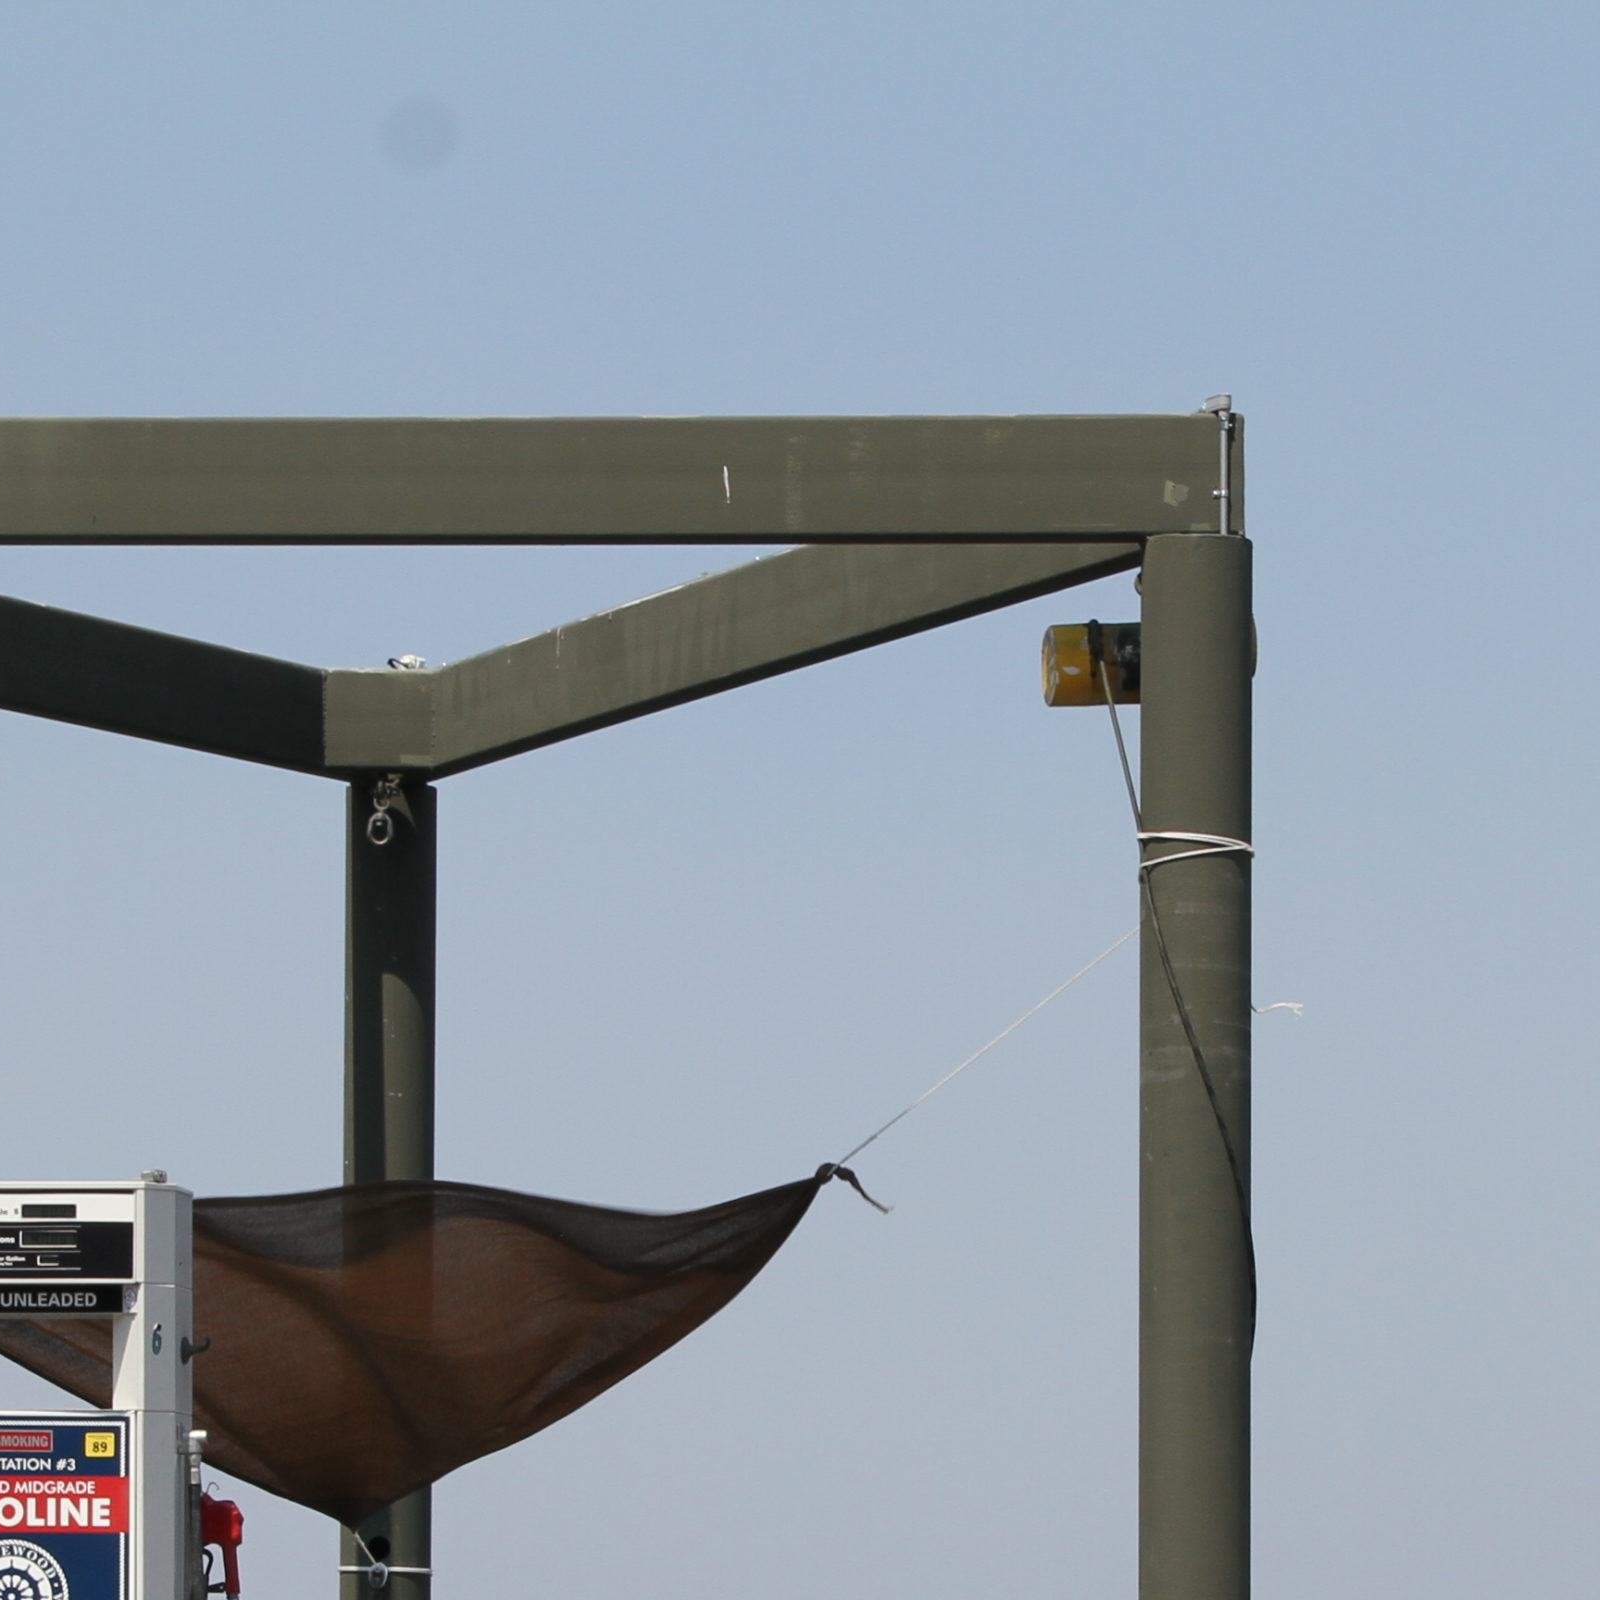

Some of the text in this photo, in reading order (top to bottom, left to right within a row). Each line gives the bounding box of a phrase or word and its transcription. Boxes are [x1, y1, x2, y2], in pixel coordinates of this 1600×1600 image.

[0, 1292, 98, 1308] UNLEADED
[151, 1322, 162, 1356] 6
[92, 1441, 108, 1454] 89
[55, 1458, 77, 1472] #3
[14, 1480, 96, 1495] MIDGRADE
